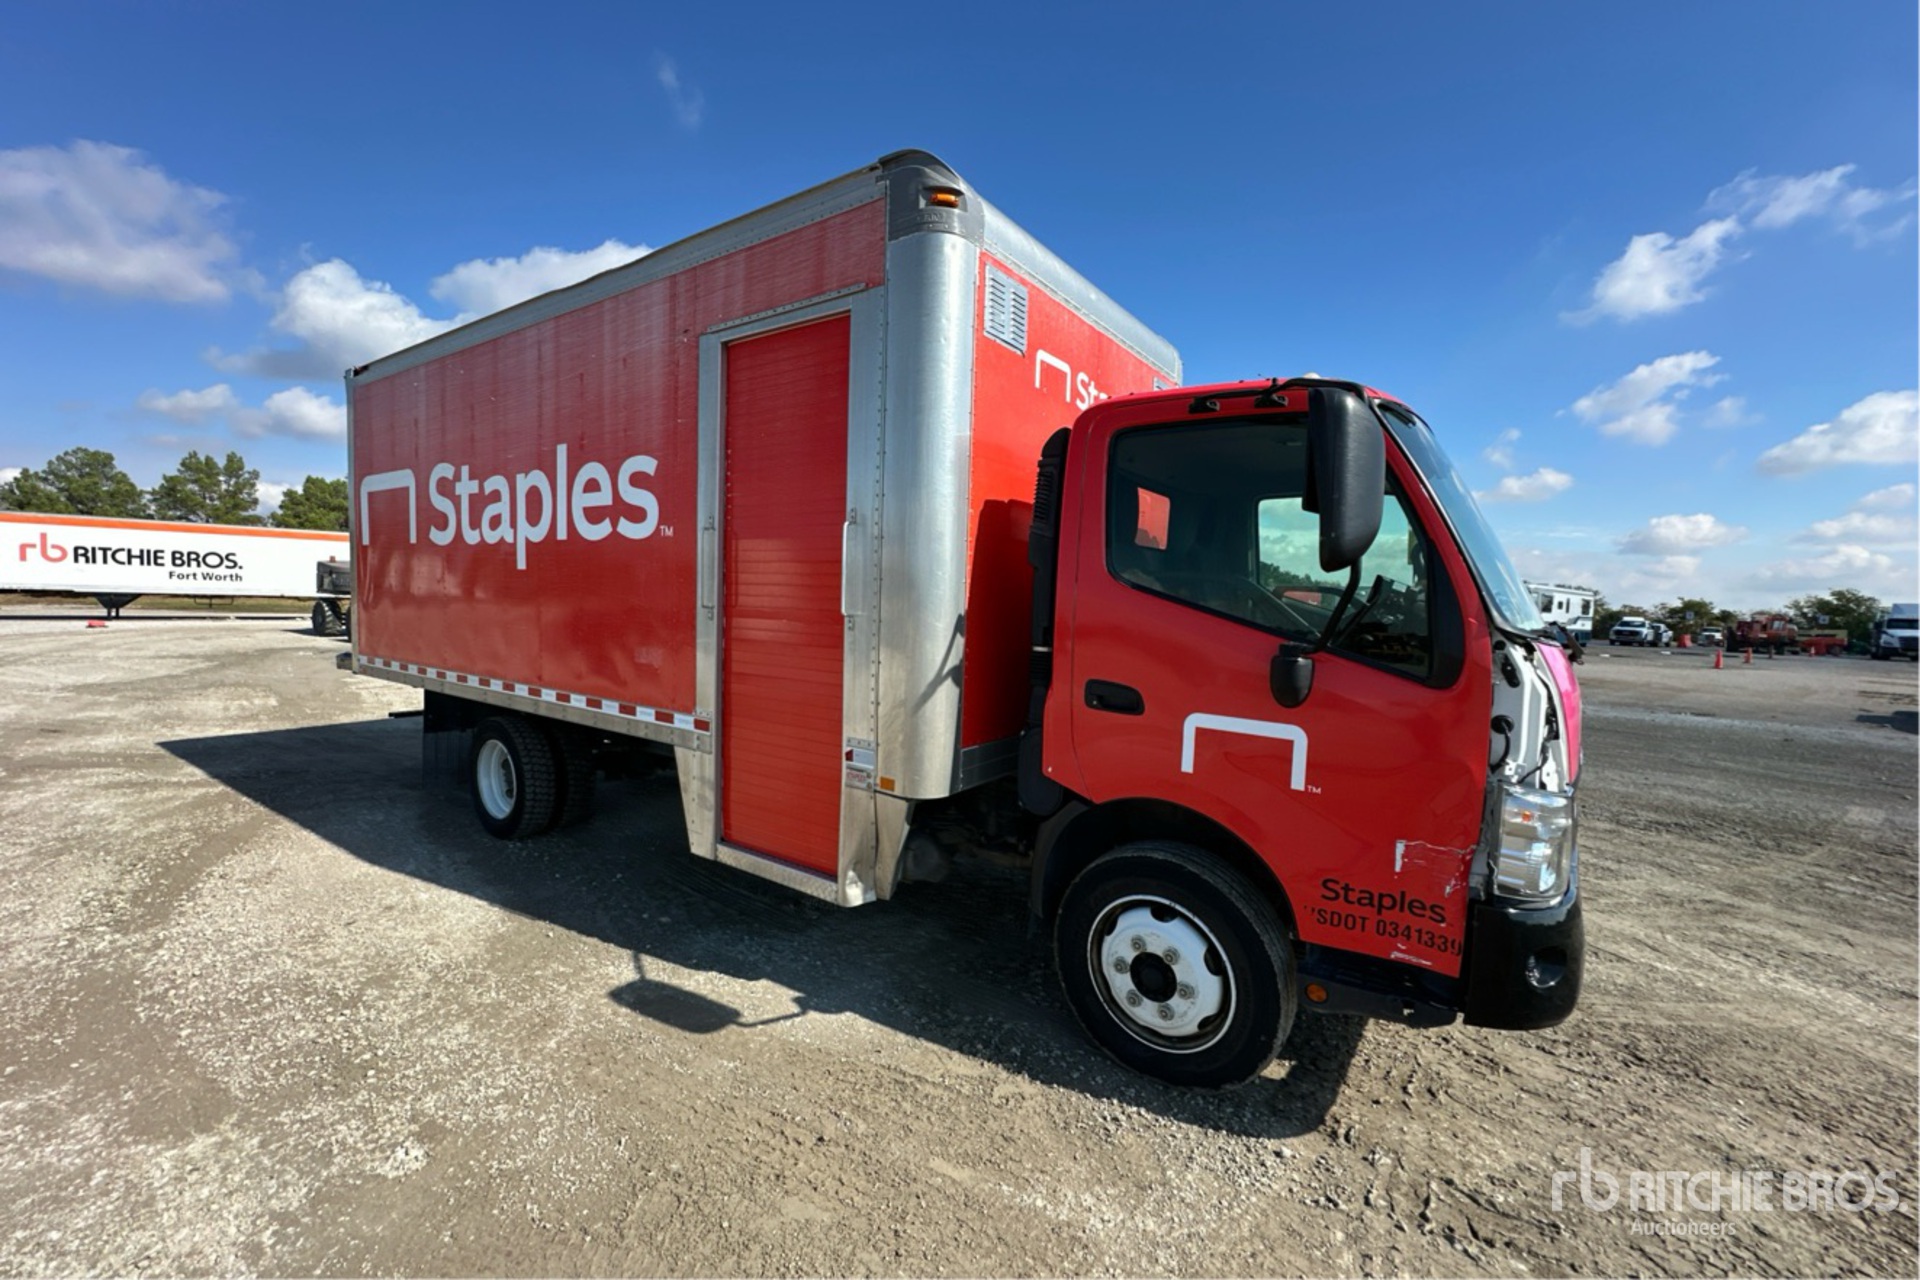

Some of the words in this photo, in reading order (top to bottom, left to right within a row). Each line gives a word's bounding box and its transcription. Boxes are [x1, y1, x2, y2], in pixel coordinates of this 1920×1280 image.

[428, 443, 660, 570] Staples
[73, 546, 165, 567] RITCHIE
[171, 551, 243, 570] BROS.
[168, 571, 199, 582] Fort
[201, 572, 243, 583] Worth
[1320, 878, 1447, 924] Staples
[1303, 906, 1369, 933] SDOT
